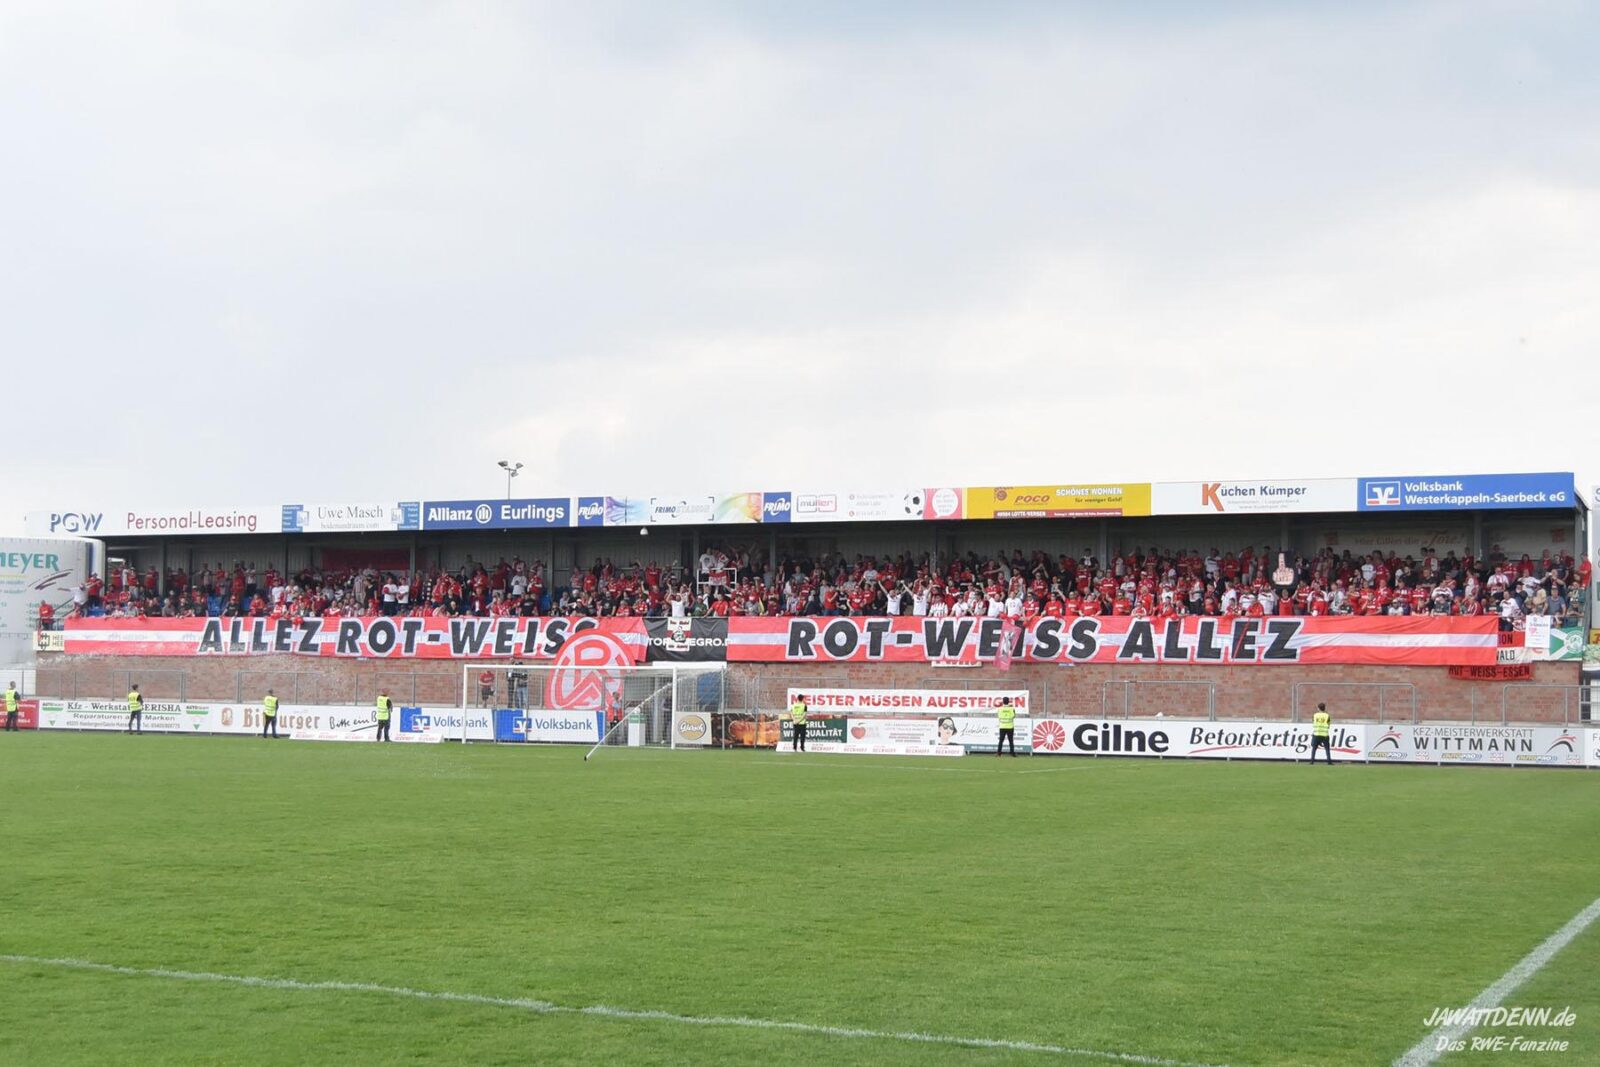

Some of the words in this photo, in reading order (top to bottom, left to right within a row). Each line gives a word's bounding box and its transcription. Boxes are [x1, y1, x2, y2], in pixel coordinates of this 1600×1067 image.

[1405, 481, 1463, 492] Volksbank
[1014, 494, 1050, 504] POCO
[1202, 482, 1256, 512] Küchen
[1260, 485, 1307, 501] Kümper
[1405, 491, 1546, 507] Westerkappeln-Saerbeck
[1549, 492, 1566, 502] eG
[317, 506, 344, 519] Uwe
[346, 505, 384, 518] Masch
[428, 507, 473, 522] Allianz
[501, 504, 565, 523] Eurlings
[655, 506, 677, 514] FRIMO
[763, 498, 792, 516] FRIMO
[50, 512, 103, 533] PGW
[127, 510, 258, 532] Personal-Leasing
[199, 618, 323, 653] ALLEZ
[787, 619, 1098, 660] ROT-WEISS
[1117, 619, 1303, 660] ALLEZ
[858, 694, 922, 707] MÜSSEN
[243, 707, 320, 729] Biurger
[535, 717, 593, 731] Volksbank
[1073, 723, 1169, 753] Gilne
[1190, 727, 1358, 754] Betonfertigile
[1412, 727, 1534, 738] KFZ-MEISTERWERKSTATT
[1413, 737, 1533, 751] WITTMANN
